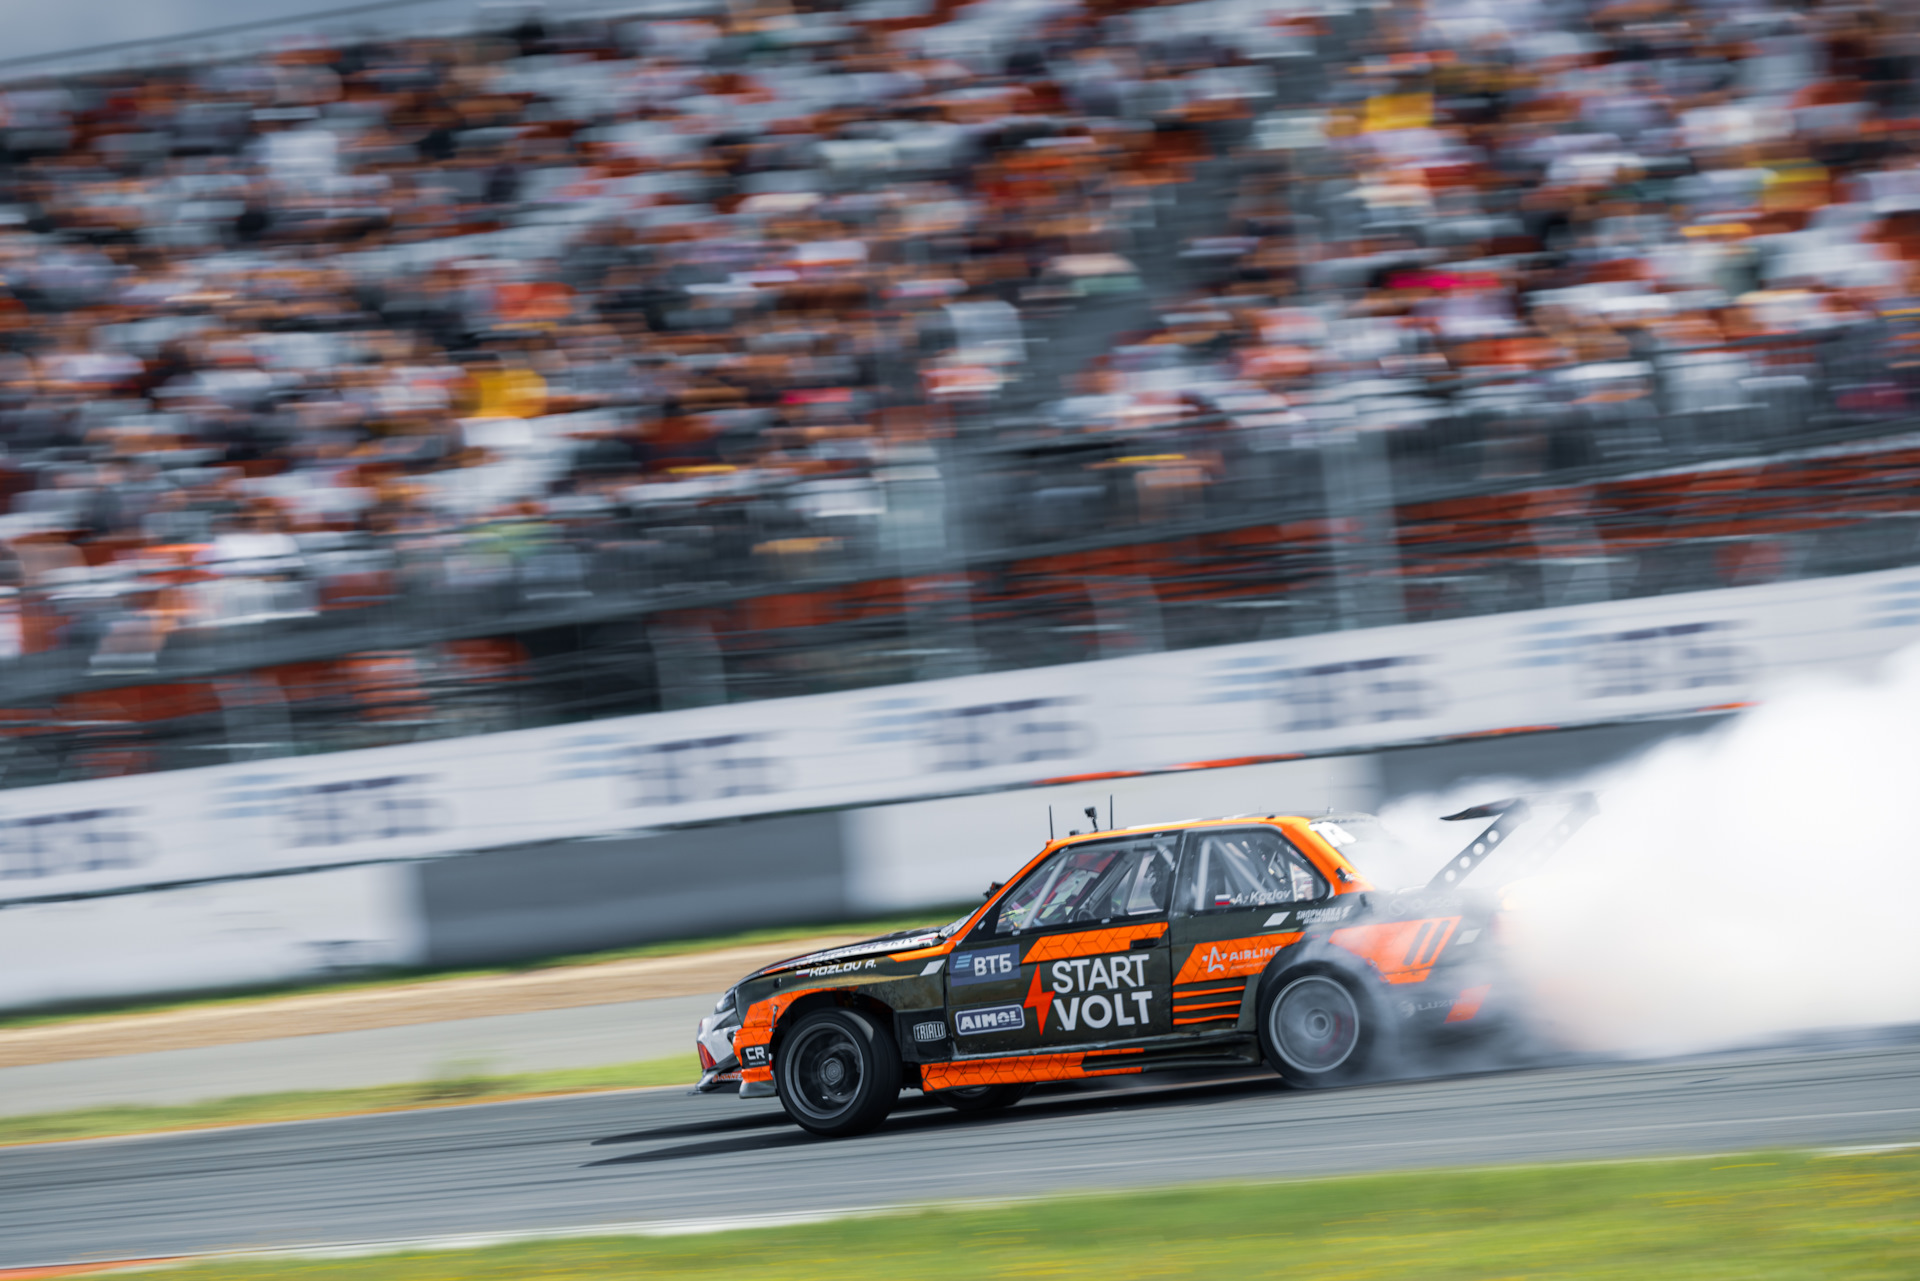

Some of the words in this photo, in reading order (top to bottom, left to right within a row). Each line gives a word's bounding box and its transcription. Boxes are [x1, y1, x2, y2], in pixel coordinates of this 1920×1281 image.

[1249, 889, 1291, 904] Kozlov
[809, 960, 862, 977] KOZLOV
[864, 958, 877, 970] A.
[973, 952, 1012, 977] ВТБ
[1052, 953, 1150, 994] START
[960, 1010, 1021, 1031] AIMOL
[1053, 990, 1153, 1032] VOLT
[916, 1023, 944, 1040] TRIALLI
[745, 1046, 766, 1060] CR
